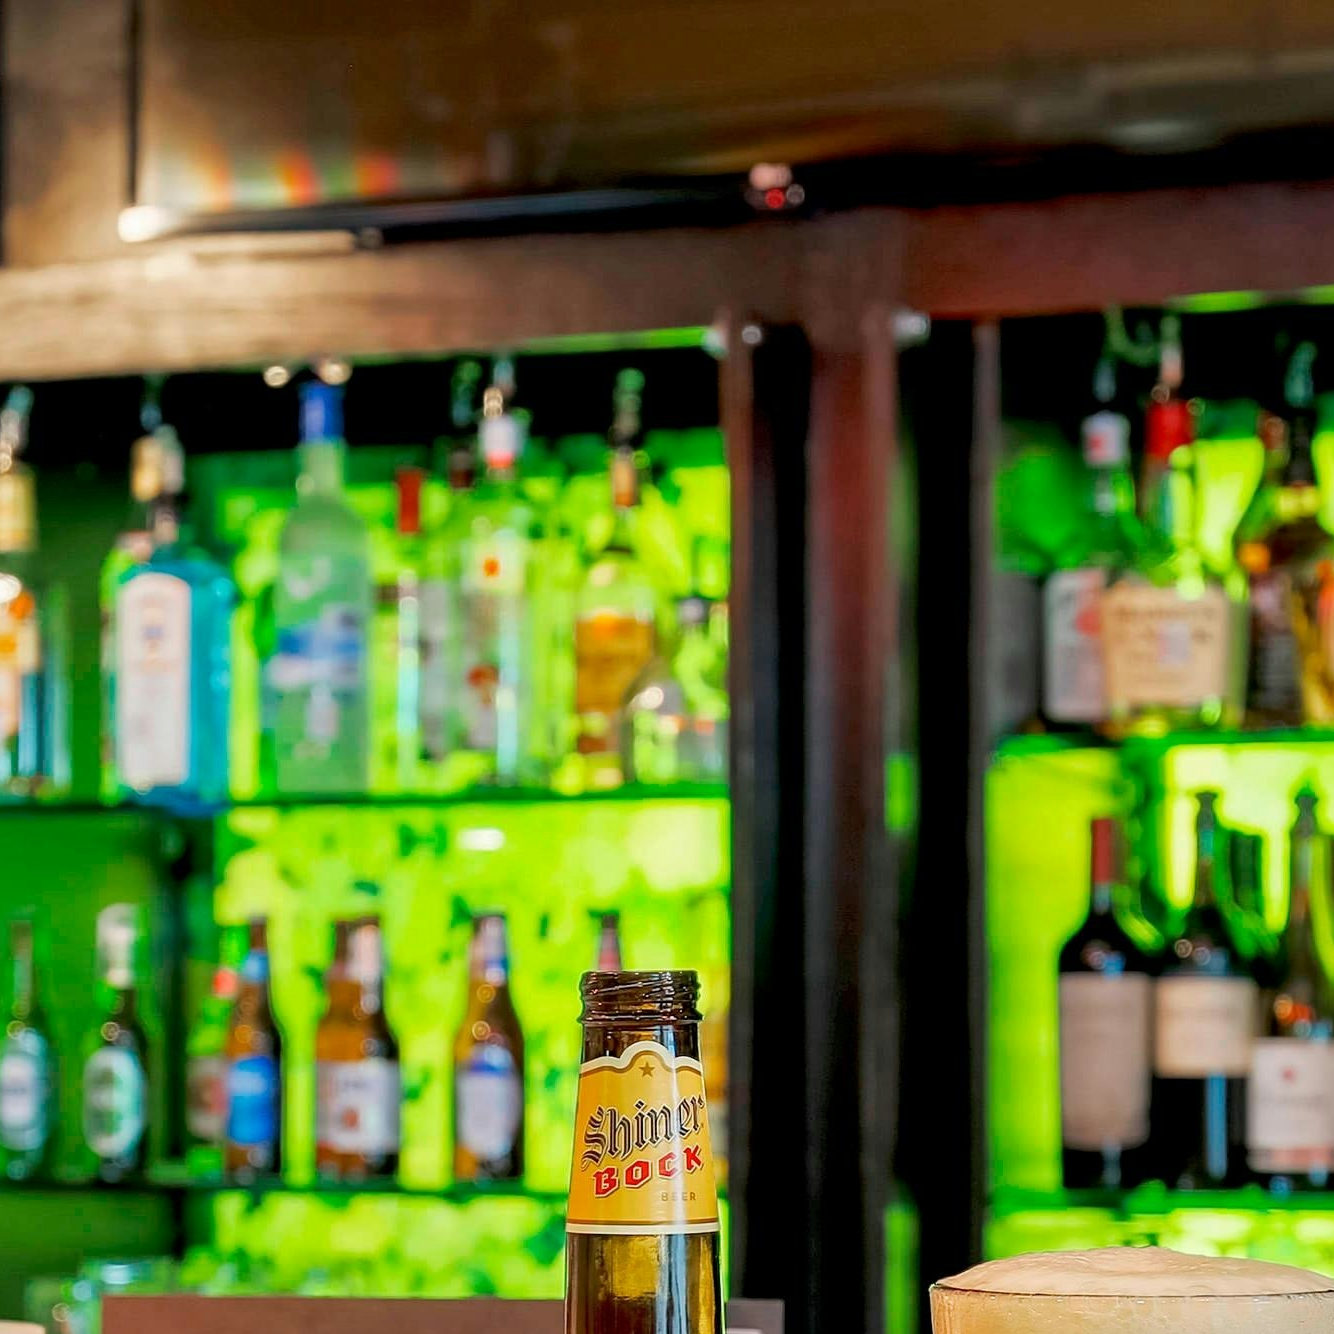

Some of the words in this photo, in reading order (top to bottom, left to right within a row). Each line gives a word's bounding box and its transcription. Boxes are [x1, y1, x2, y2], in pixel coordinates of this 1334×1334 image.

[581, 1094, 705, 1172] Shiner
[593, 1145, 703, 1198] BOCK
[661, 1191, 696, 1201] BEER
